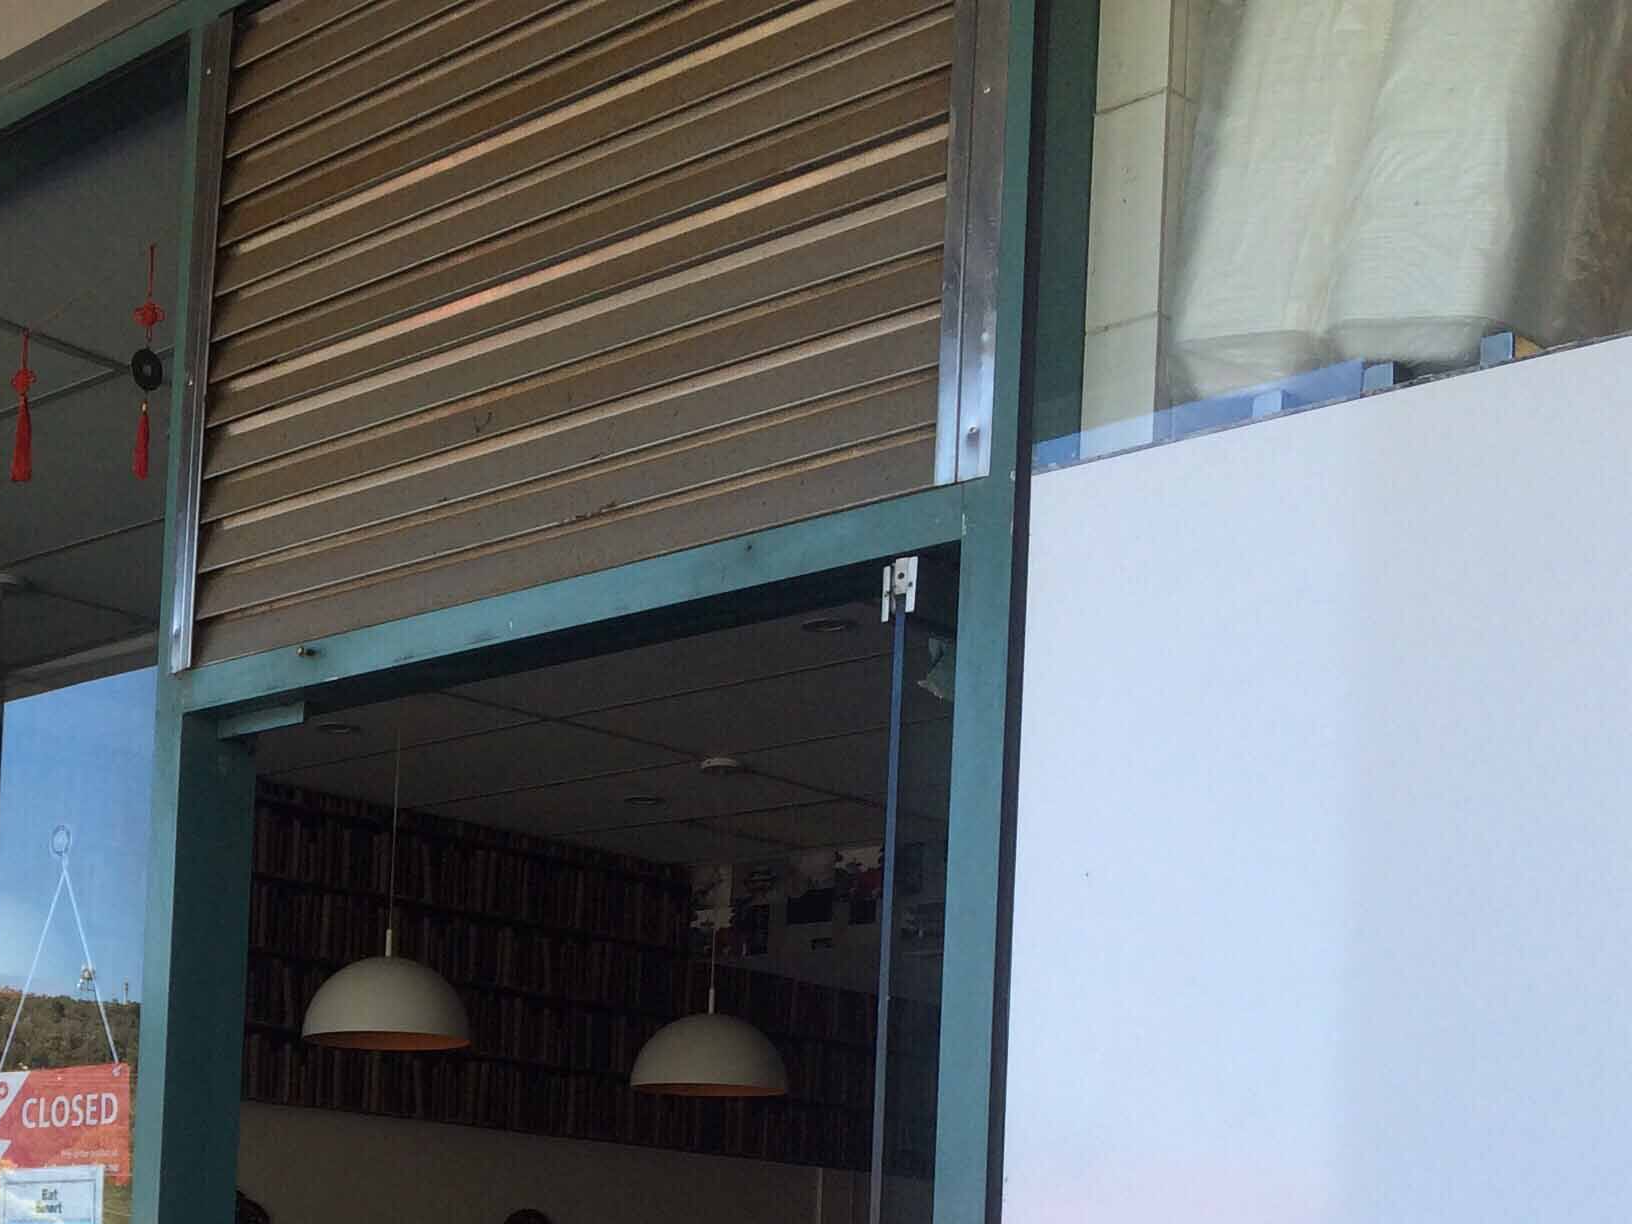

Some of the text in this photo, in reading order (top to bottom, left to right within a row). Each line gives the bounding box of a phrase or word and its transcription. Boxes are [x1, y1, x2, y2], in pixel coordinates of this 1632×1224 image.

[21, 1092, 119, 1129] CLOSED
[41, 1188, 58, 1201] Eat
[35, 1202, 63, 1214] Smart
